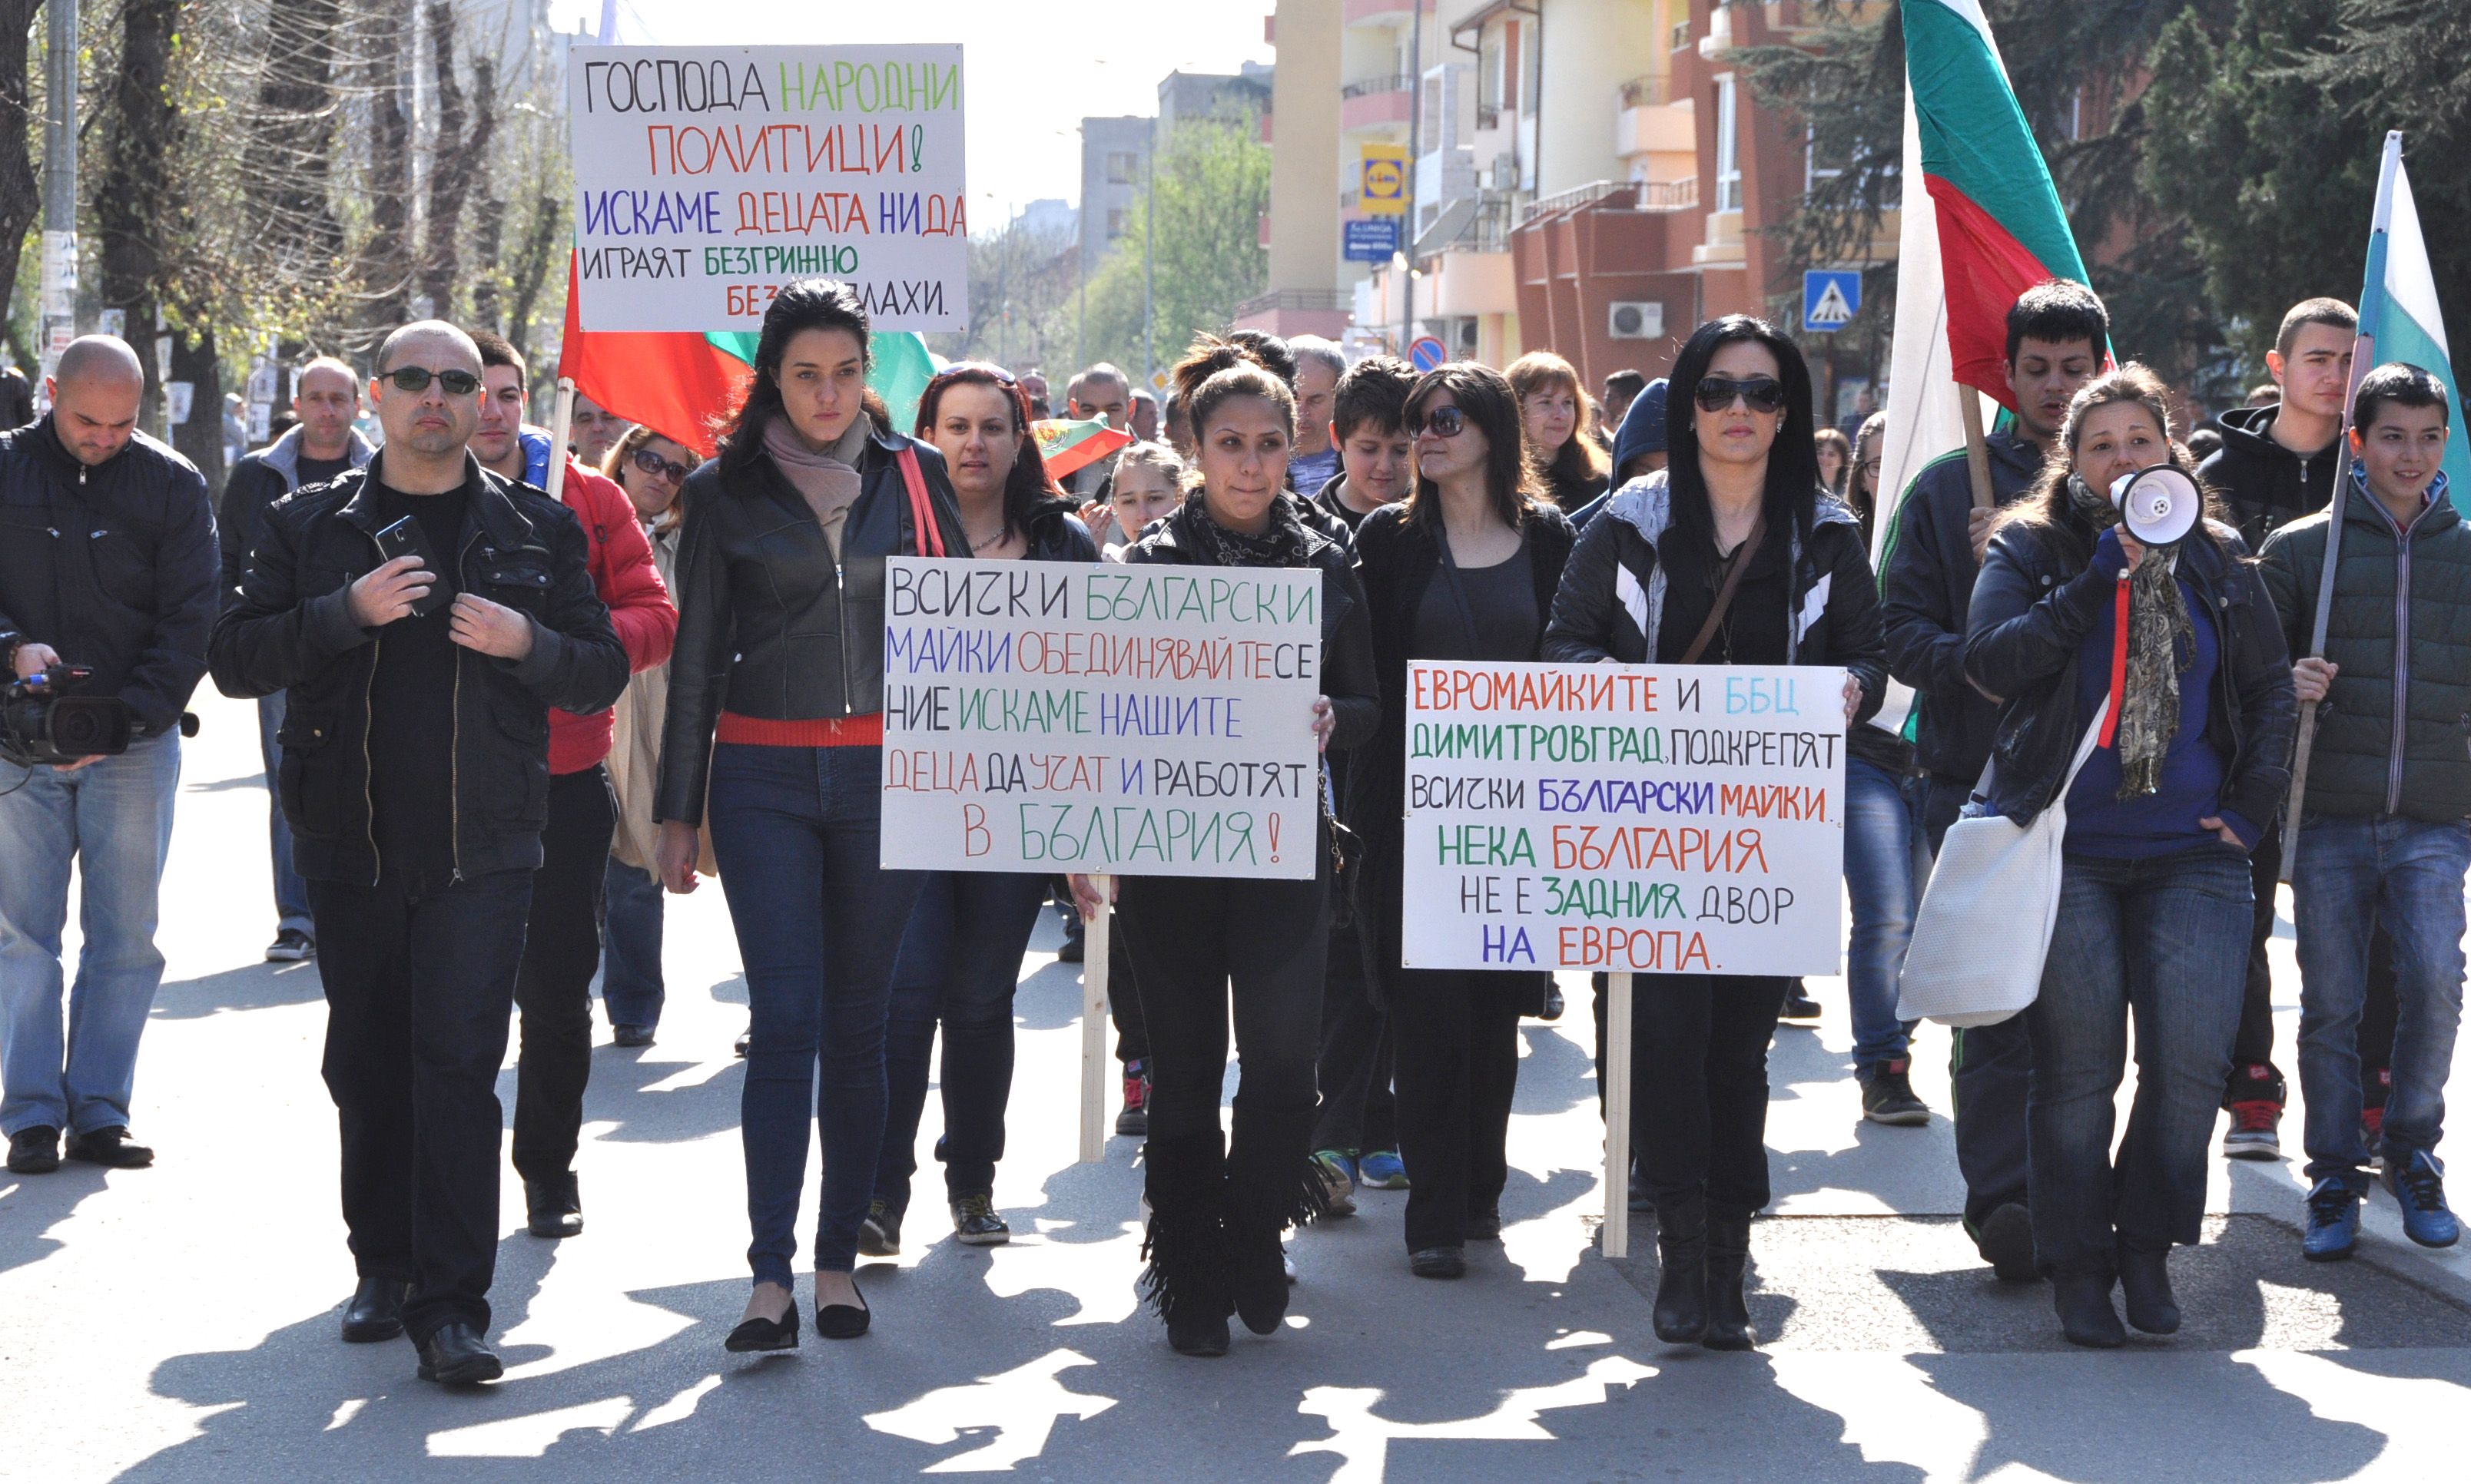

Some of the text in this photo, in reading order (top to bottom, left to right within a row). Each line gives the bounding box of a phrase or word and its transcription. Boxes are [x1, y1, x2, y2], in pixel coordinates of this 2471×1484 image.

[585, 59, 957, 113] ГОСПОДА НАРОДНИ
[648, 124, 923, 175] ПОЛИТИЦИ!
[584, 190, 967, 237] ИСКАМЕ ДЕЦАТА НИ ДА
[582, 247, 692, 279] ИГРАЯТ
[892, 568, 1313, 624] ВСИЧКИ БЪЛГАРСКИ
[887, 625, 1010, 673] МАЙКИ
[886, 685, 1242, 737] НИЕ ИСКАМЕ НАШИТЕ
[1414, 669, 1799, 716] ЕВРОМАЙКИТЕ И ББЦ
[1672, 729, 1842, 769] ПОДКРЕПЯТ
[884, 750, 1306, 797] ДЕЦА ДА УЧАТ И РАБОТЯТ
[1411, 774, 1524, 810] ВСИЧКИ
[1538, 779, 1713, 814] БЪЛГАРСКИ
[964, 804, 990, 857] В
[1438, 824, 1768, 873] НЕКА БЪЛГАРИЯ
[1461, 875, 1794, 924] НЕ Е ЗАДНИЯ ДВОР
[1483, 924, 1723, 971] НА ЕВРОПА.
